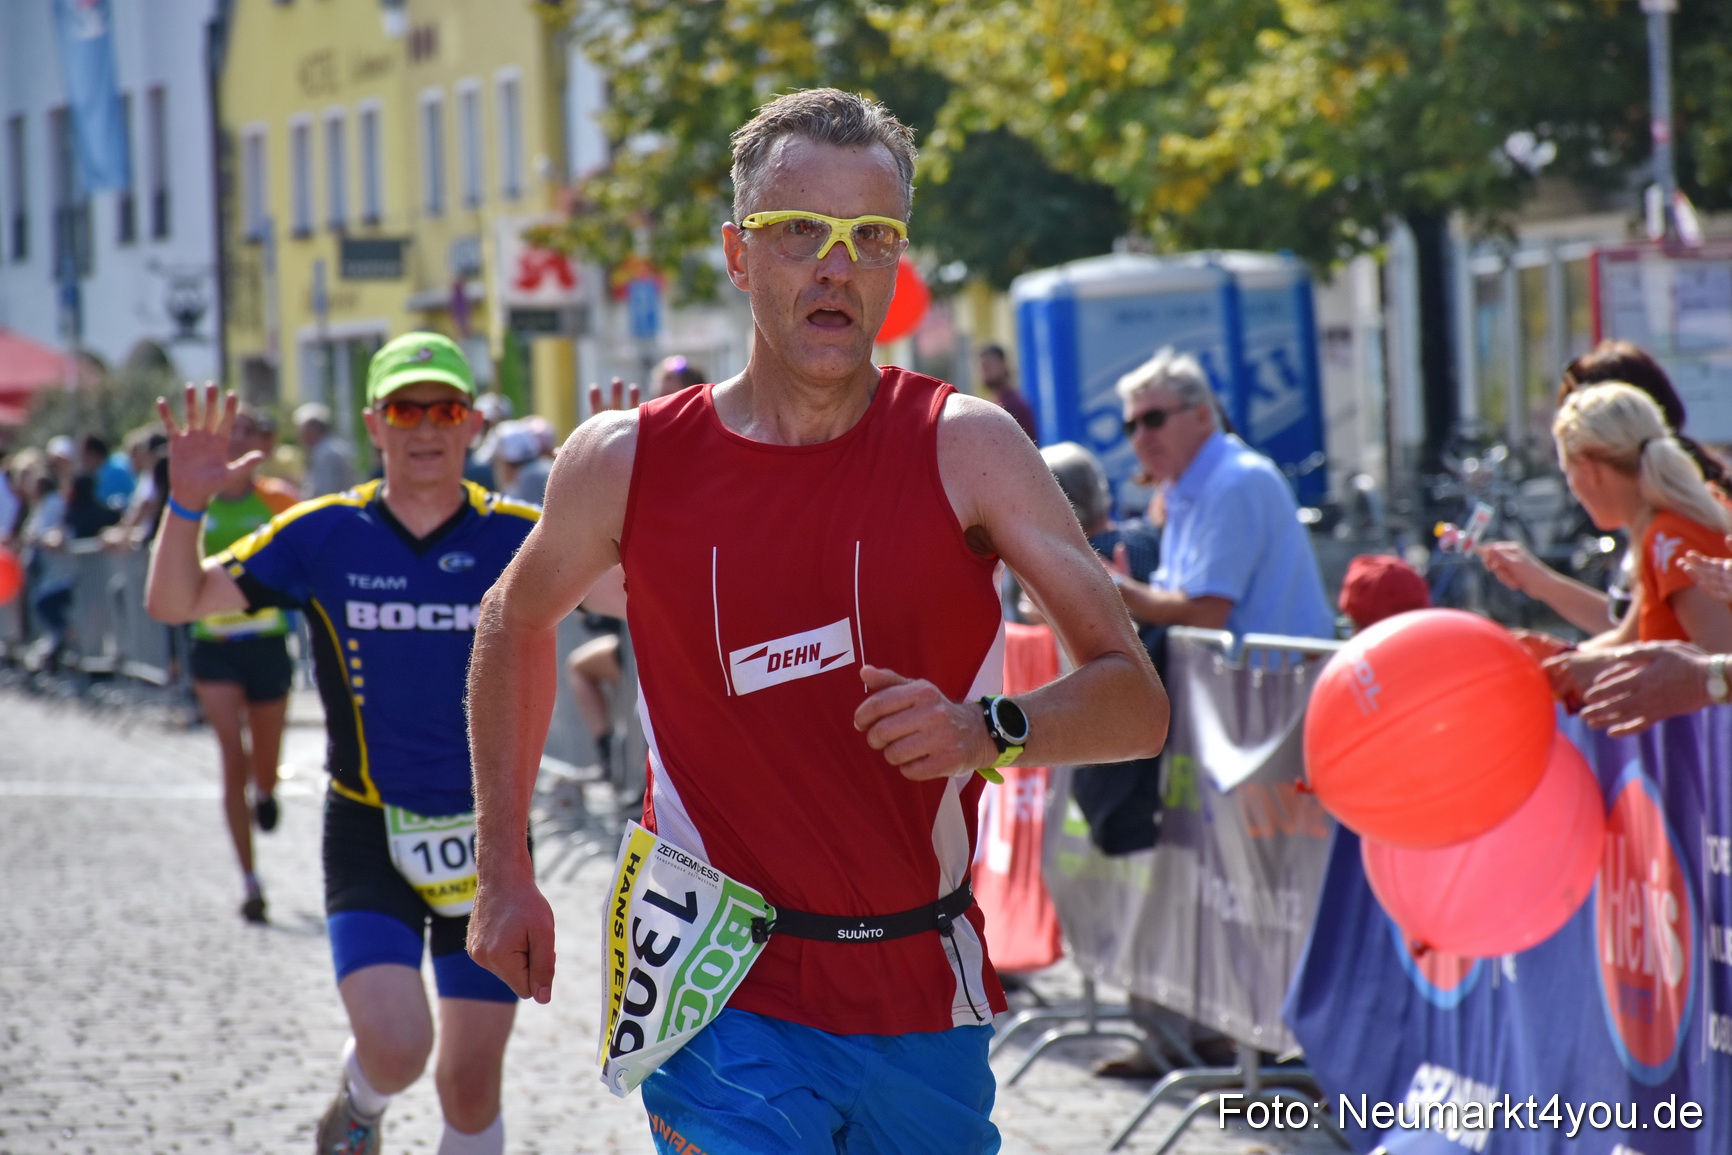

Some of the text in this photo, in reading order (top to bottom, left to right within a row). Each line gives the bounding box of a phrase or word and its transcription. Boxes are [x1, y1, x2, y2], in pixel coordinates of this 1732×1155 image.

[347, 573, 407, 590] TEAM
[767, 642, 821, 673] DEHN
[411, 832, 477, 875] 10
[614, 852, 641, 939] HANS
[838, 928, 884, 939] SUUNTO
[609, 888, 699, 1059] 1309
[670, 897, 765, 1037] BOC
